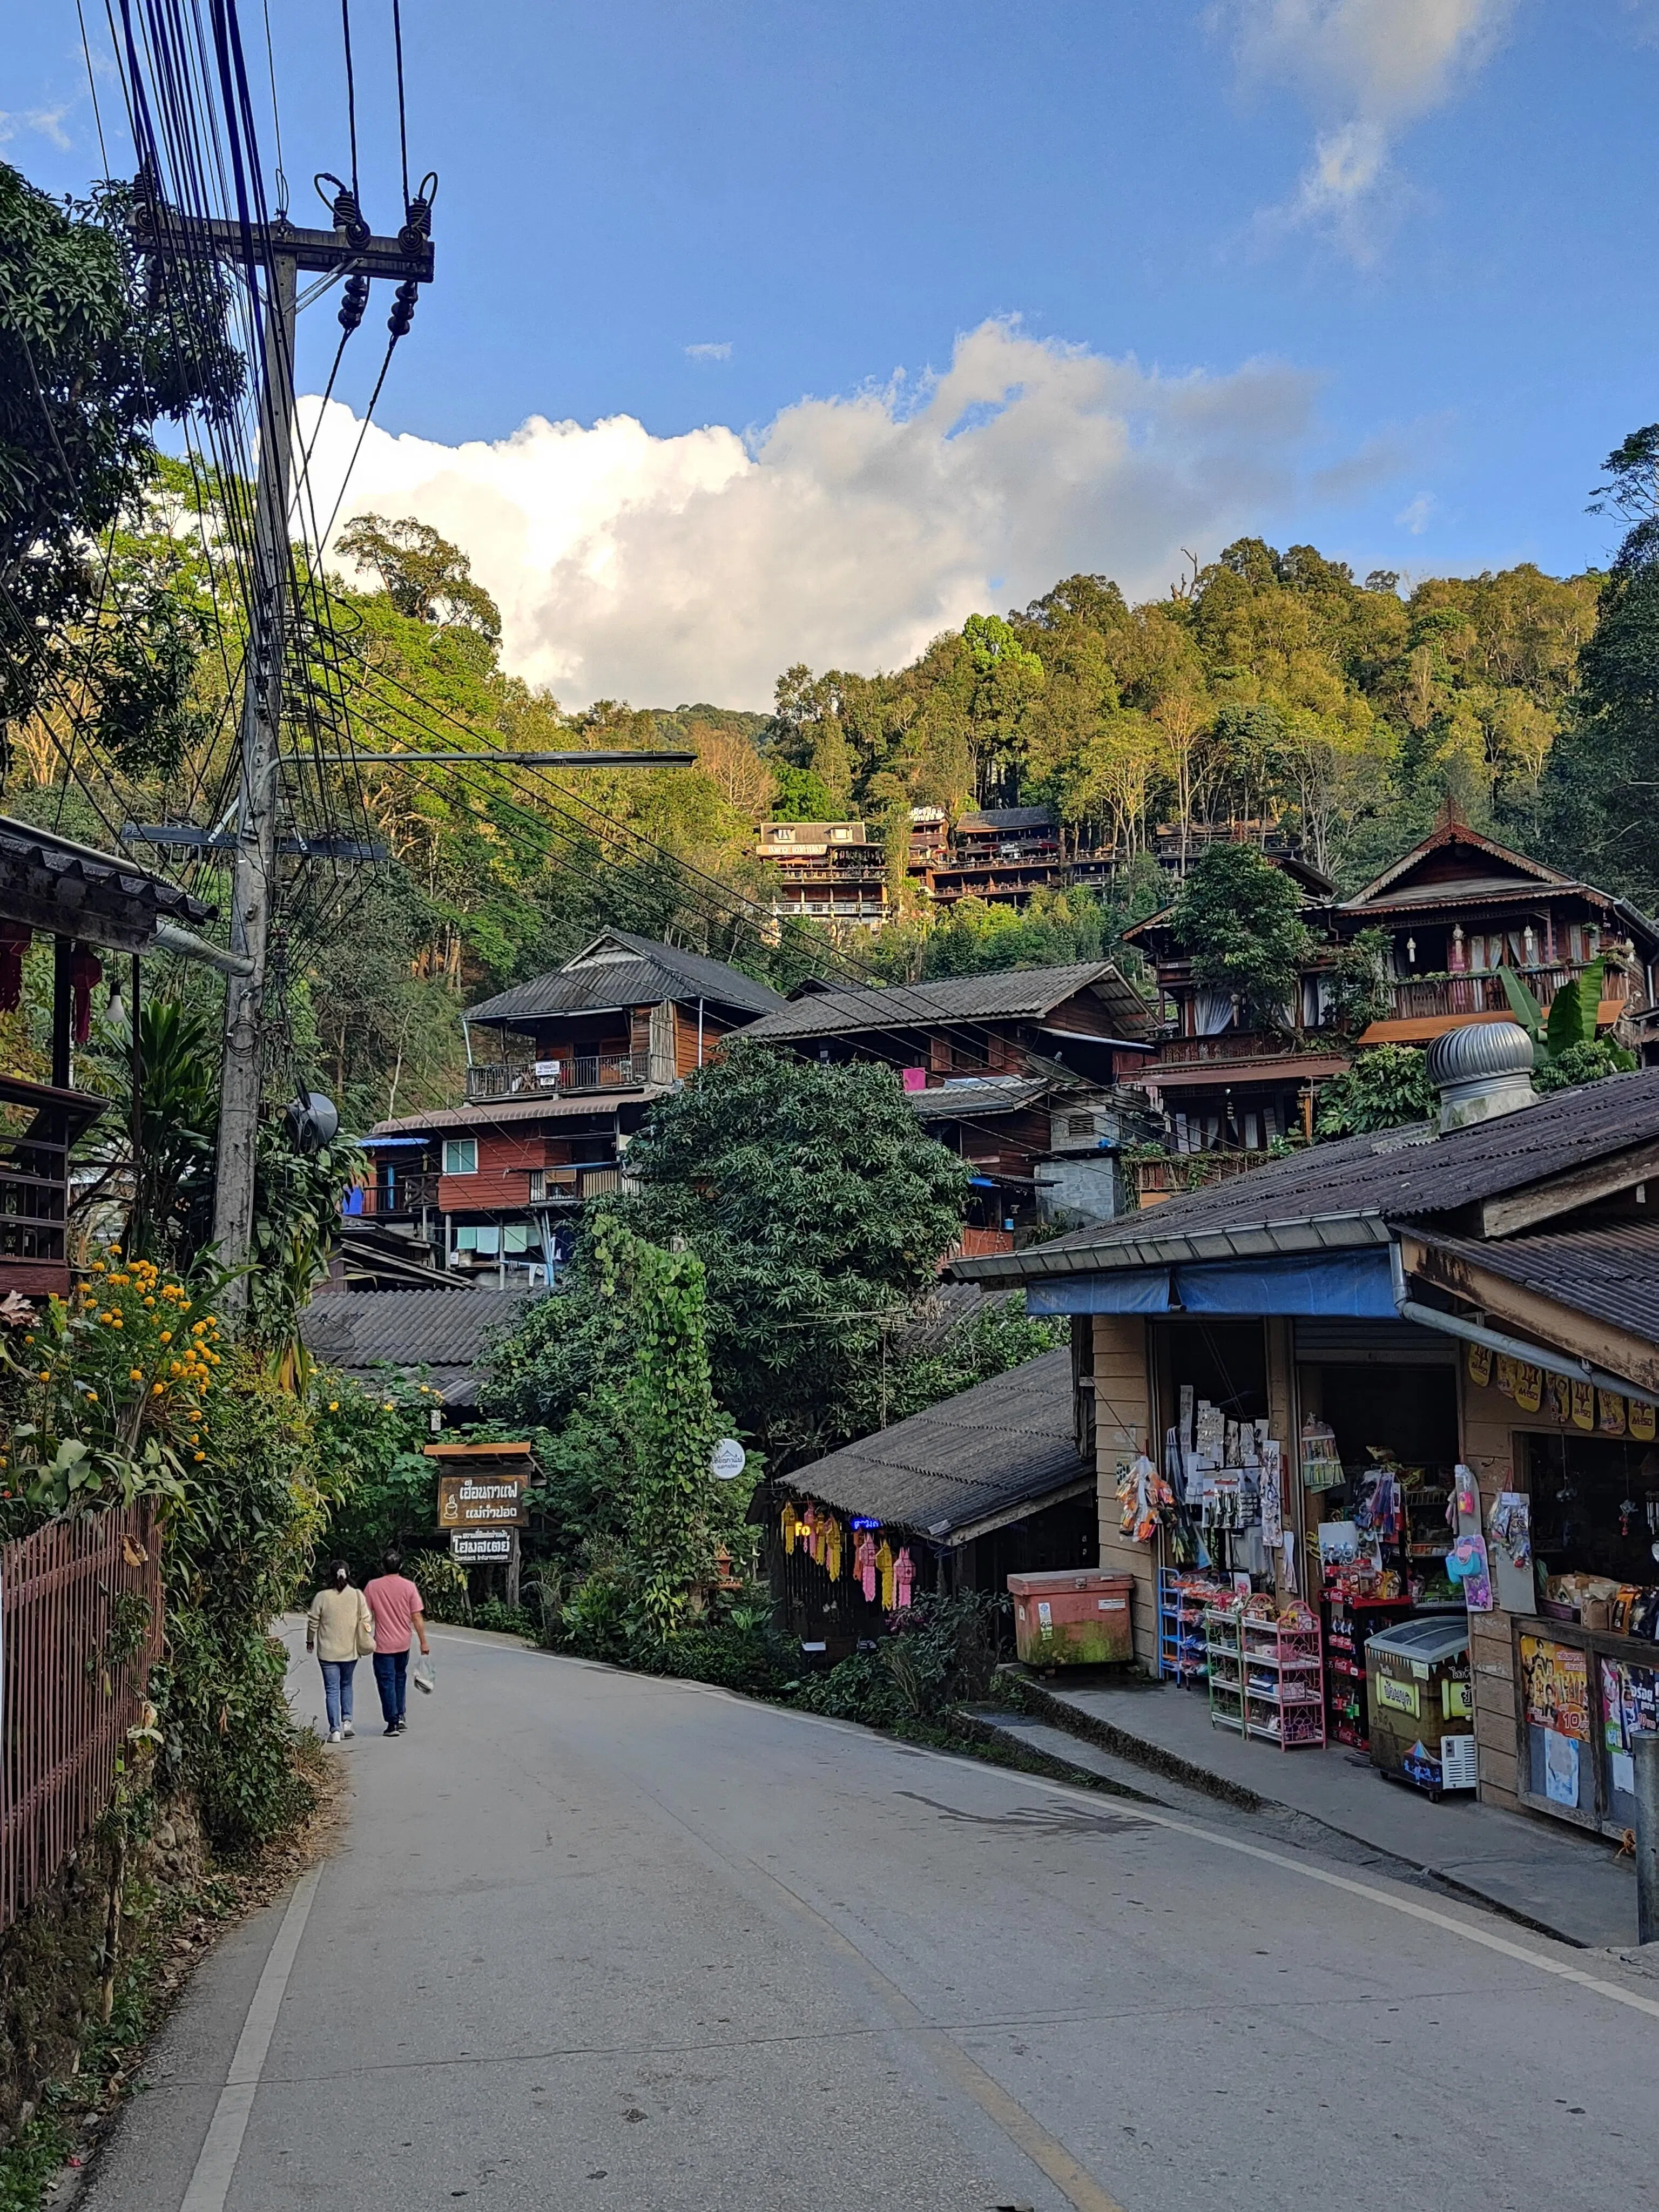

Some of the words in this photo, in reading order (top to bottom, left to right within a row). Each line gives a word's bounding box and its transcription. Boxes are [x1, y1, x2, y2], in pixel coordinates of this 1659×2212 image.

[460, 1479, 517, 1500] เฮือนกาแฟ
[466, 1505, 517, 1519] แม่กำปอง
[453, 1535, 510, 1554] โฮมสเตย์
[1563, 1711, 1580, 1729] 10
